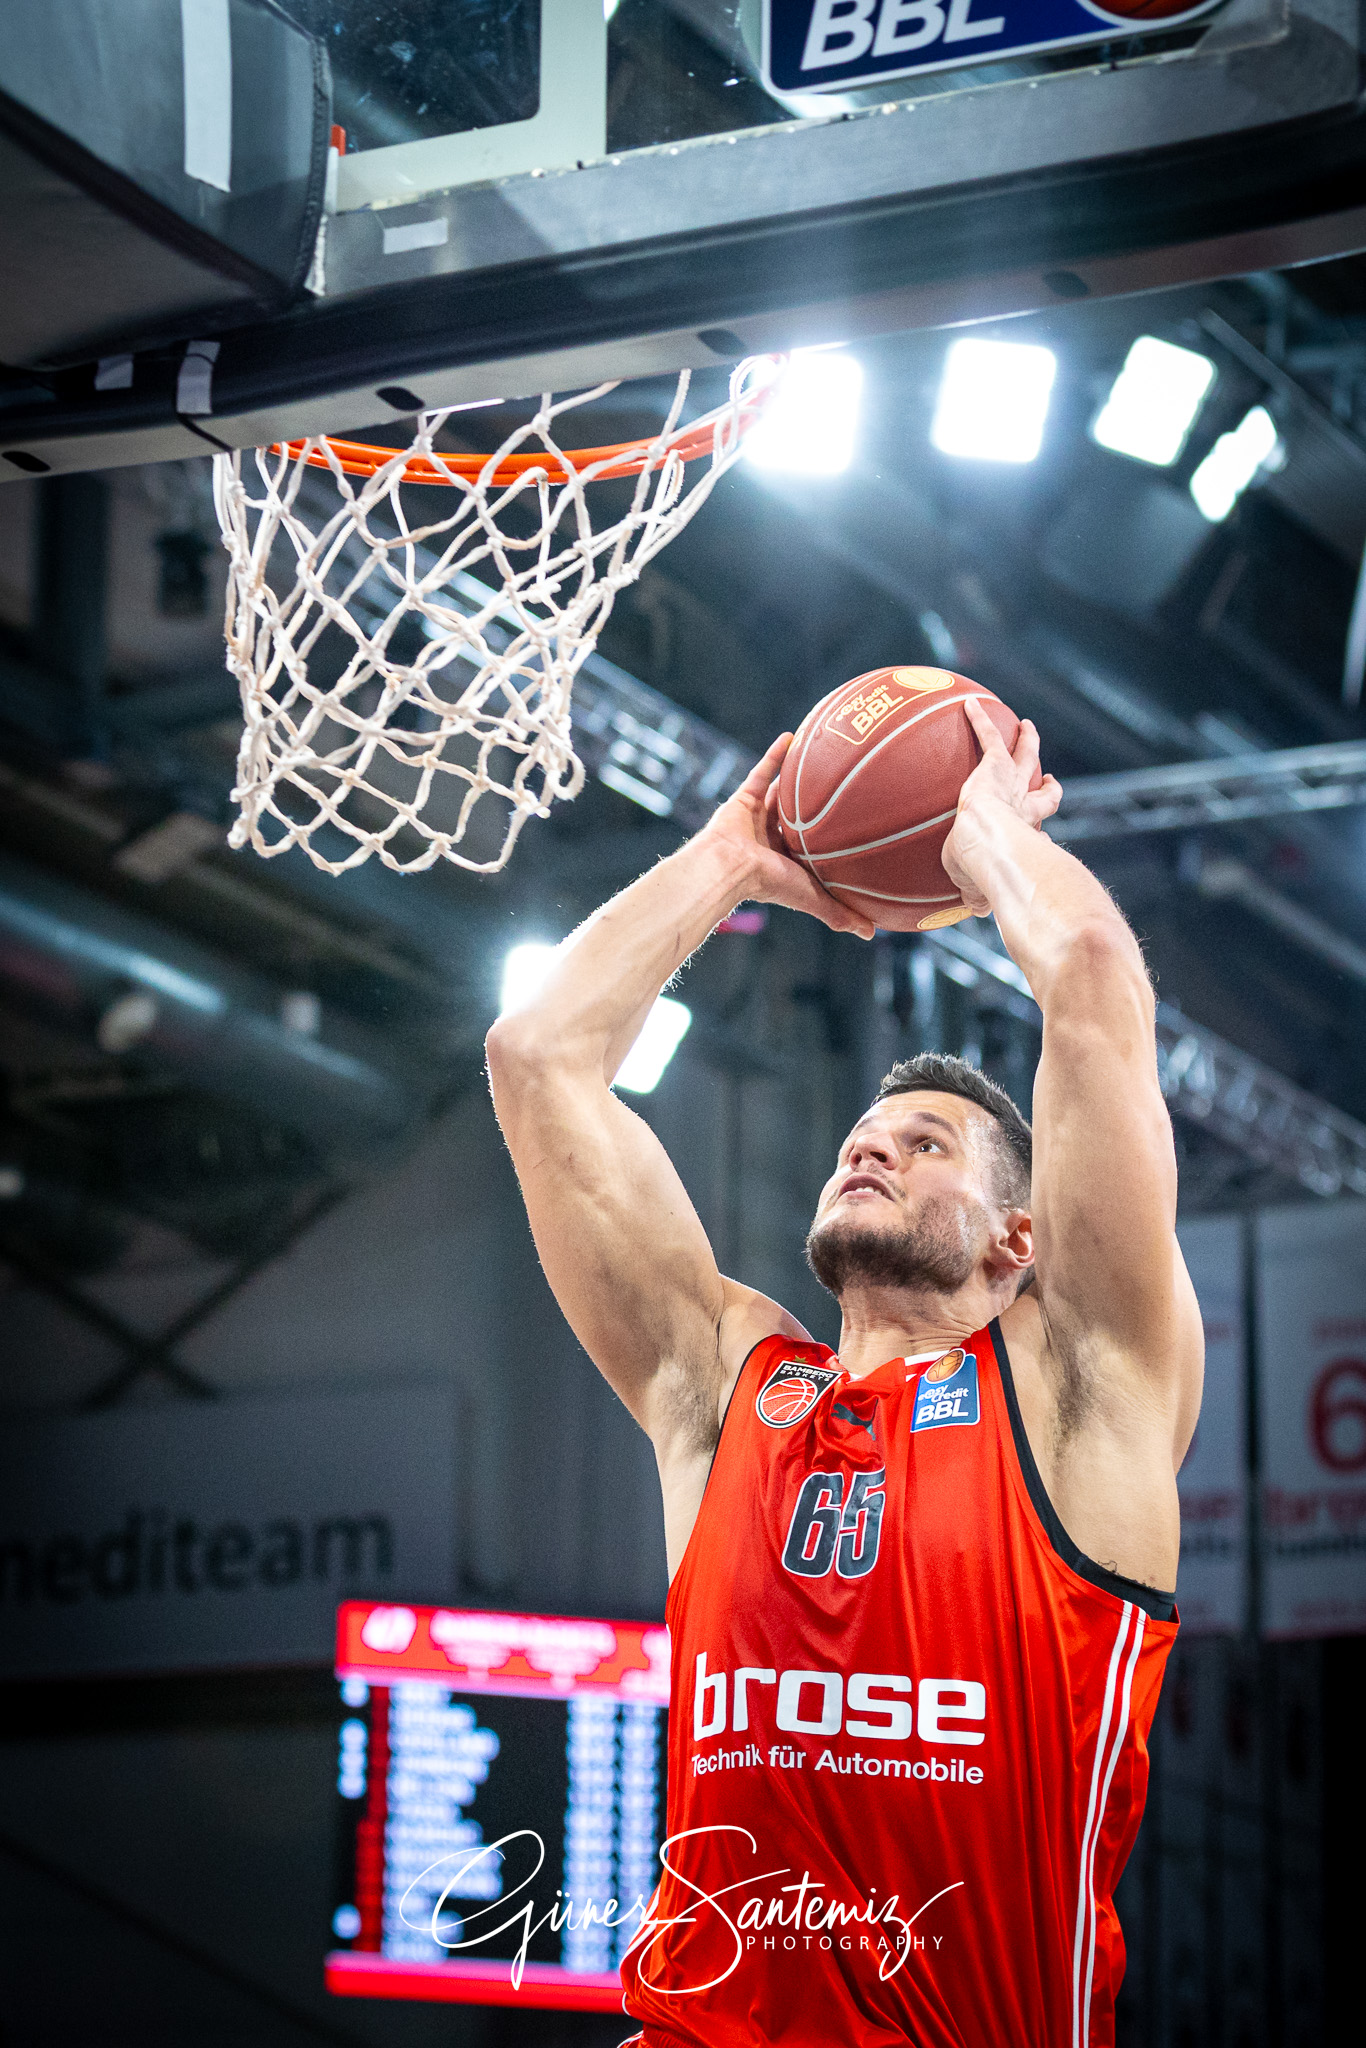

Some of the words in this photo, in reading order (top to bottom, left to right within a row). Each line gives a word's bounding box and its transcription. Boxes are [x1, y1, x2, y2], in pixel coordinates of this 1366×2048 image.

[801, 0, 1005, 71] BBL
[850, 692, 904, 735] BBL
[783, 1364, 834, 1379] BAMBERG
[915, 1398, 969, 1425] BBL
[781, 1466, 886, 1579] 65
[693, 1651, 986, 1746] brose
[691, 1743, 764, 1777] Technik
[768, 1745, 807, 1769] für
[814, 1749, 984, 1785] Automobile
